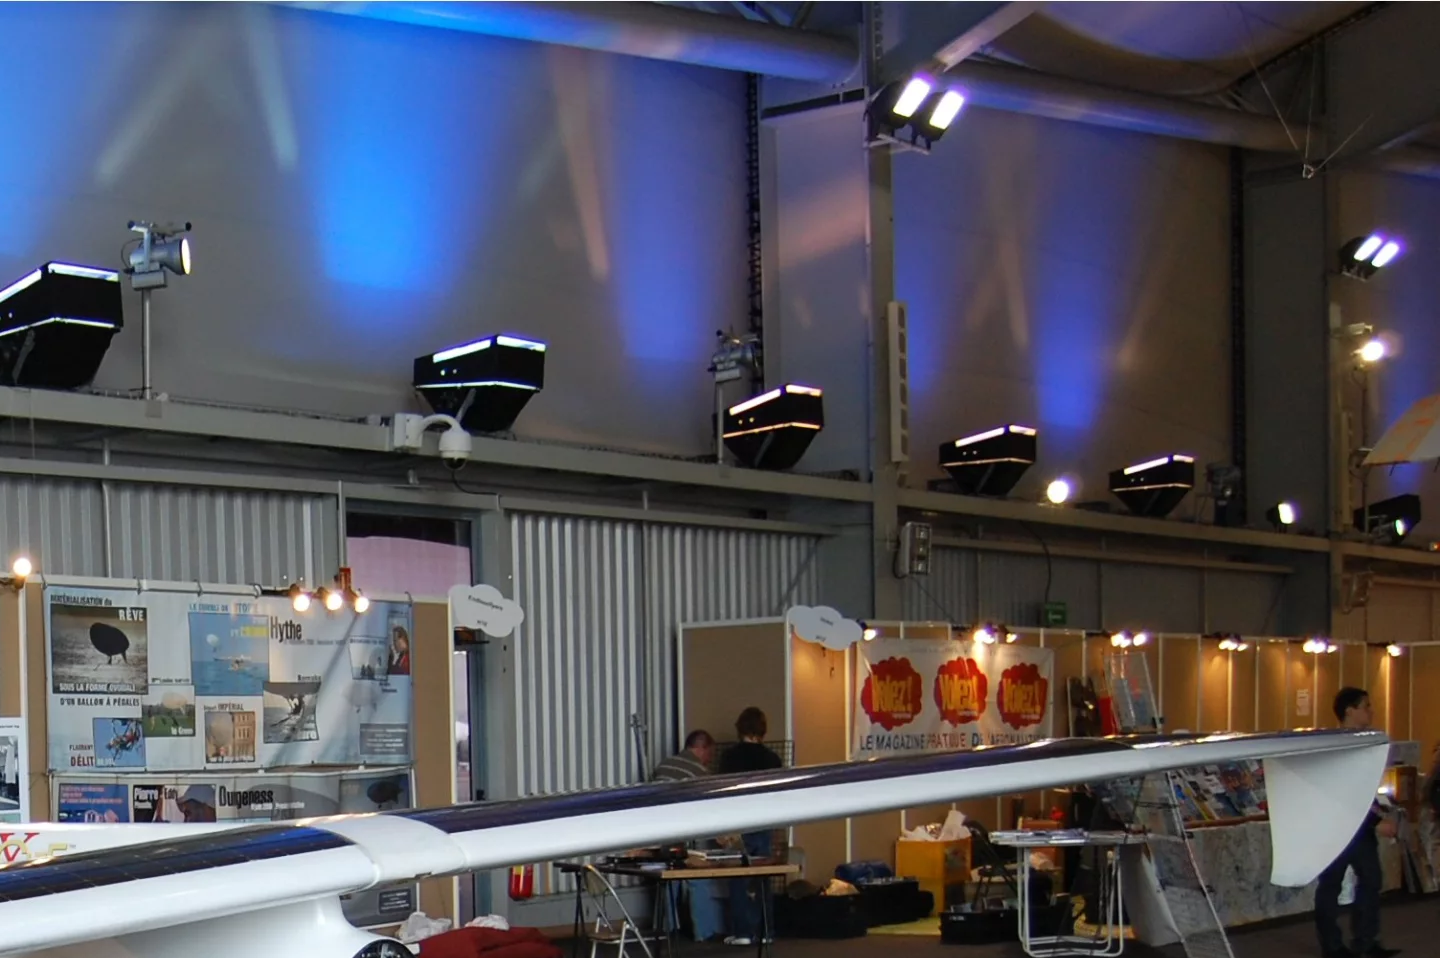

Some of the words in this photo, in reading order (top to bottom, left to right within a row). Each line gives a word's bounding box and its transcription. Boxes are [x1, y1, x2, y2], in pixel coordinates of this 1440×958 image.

[118, 606, 144, 621] RÊVE
[270, 616, 302, 643] Hythe
[77, 697, 104, 706] BALLON
[113, 697, 140, 707] PÉDALES
[872, 673, 913, 713] Volez!
[939, 673, 980, 712] Volez!
[1003, 677, 1042, 714] Volez!
[860, 735, 873, 750] LE
[876, 733, 925, 751] MAGAZINE
[70, 754, 94, 767] DÉLIT
